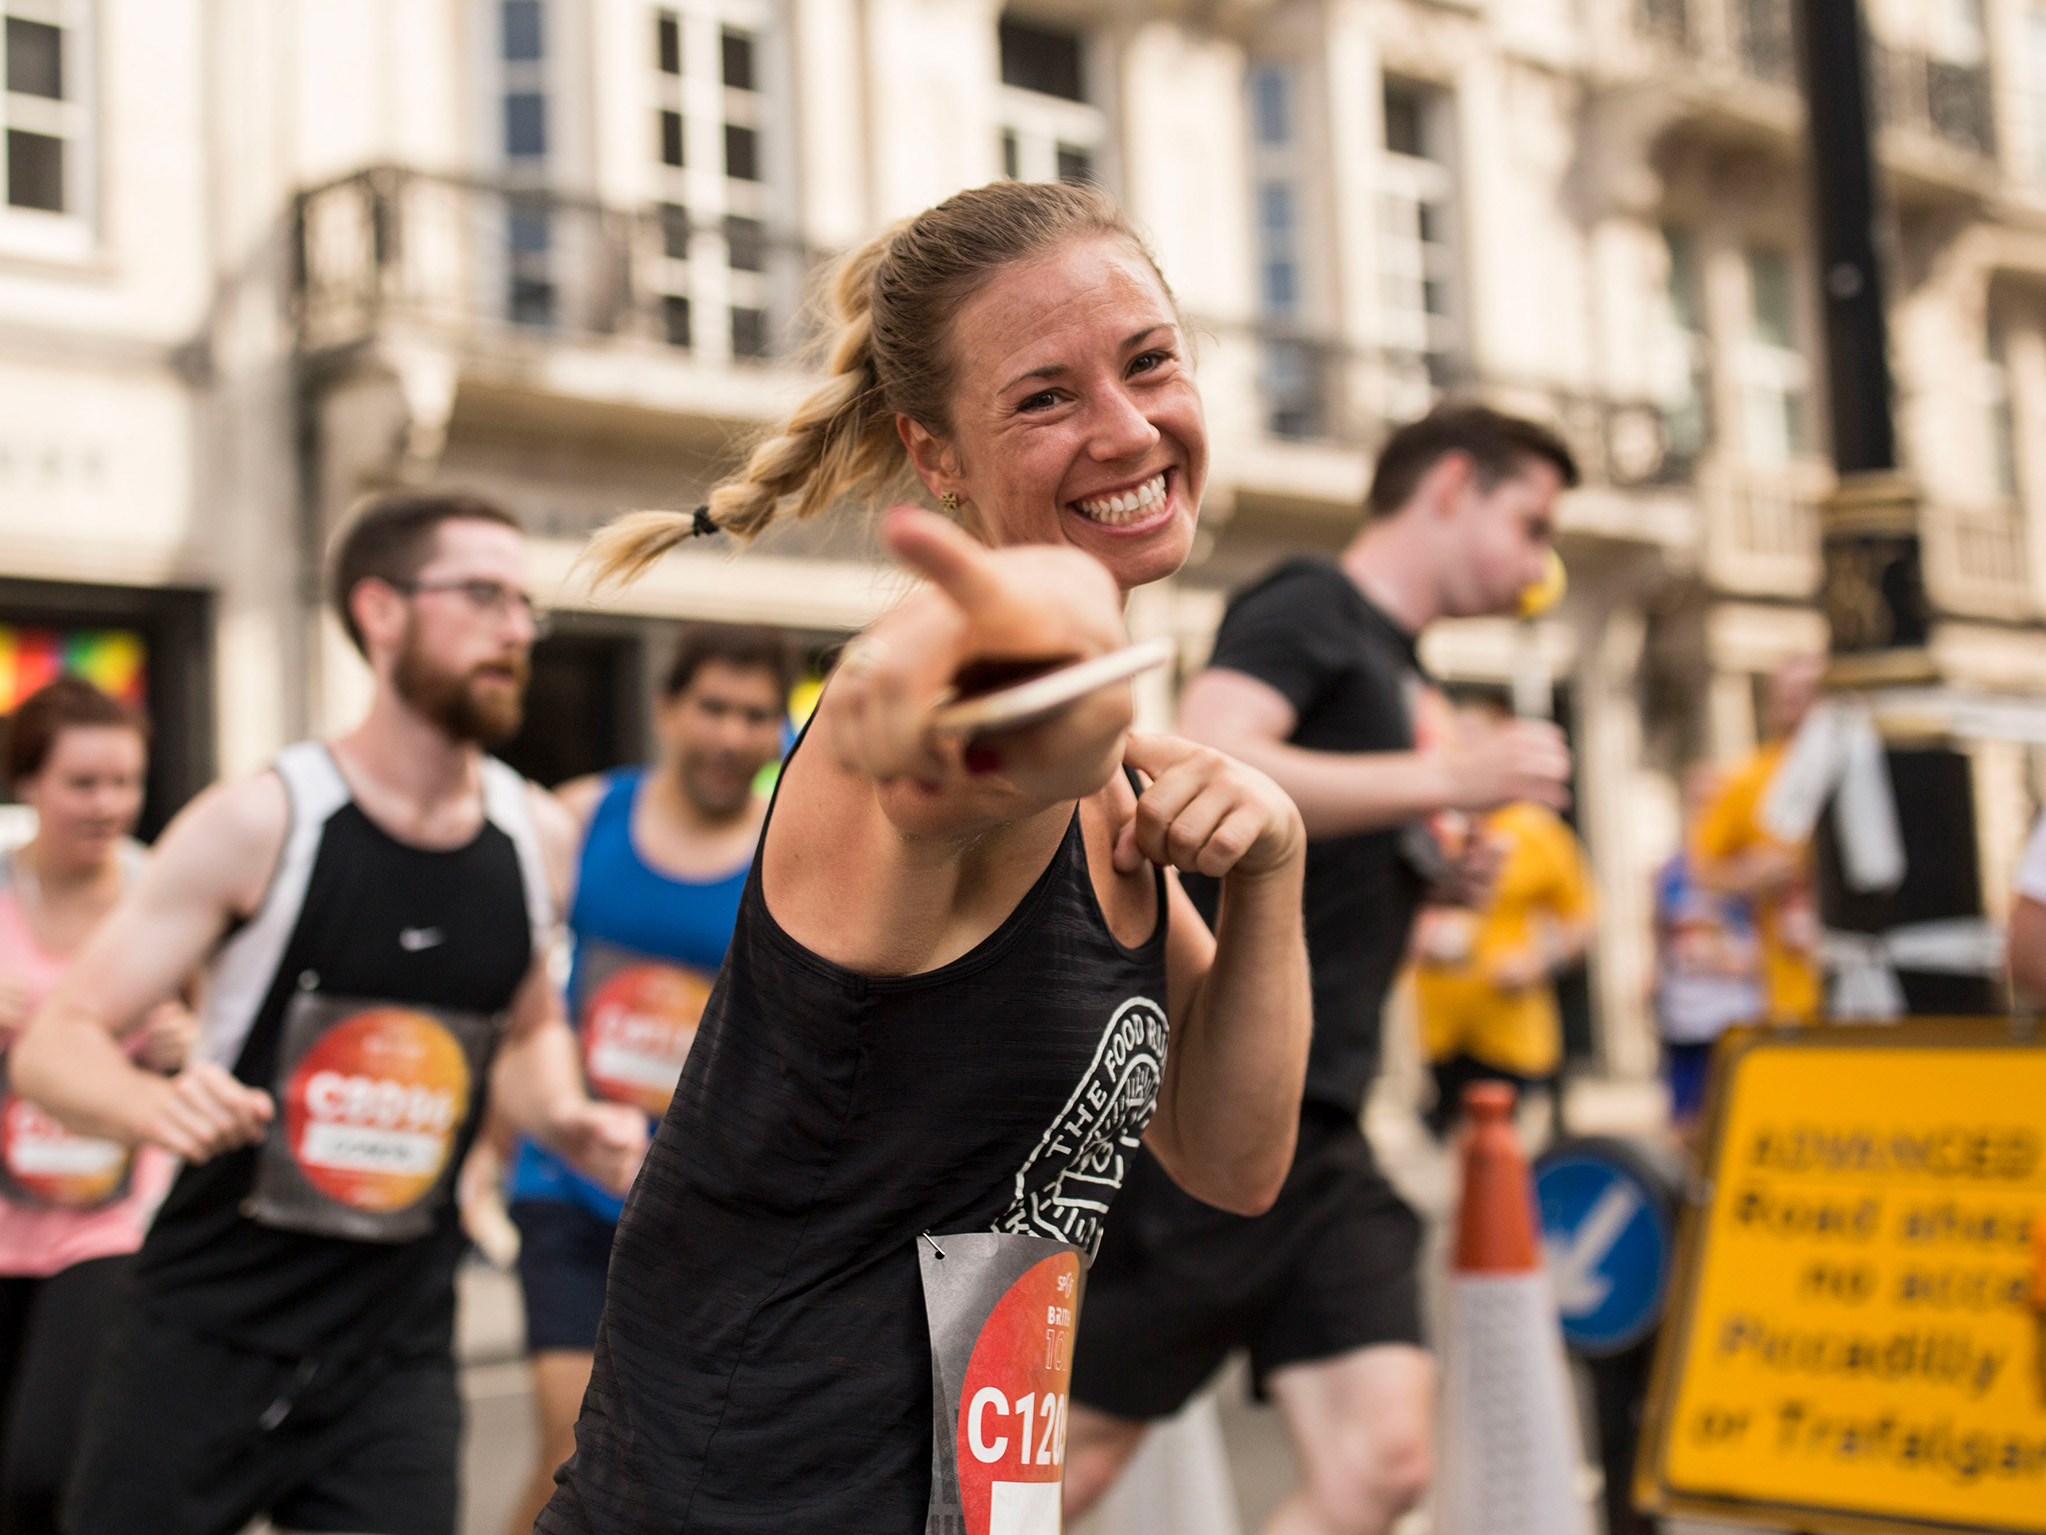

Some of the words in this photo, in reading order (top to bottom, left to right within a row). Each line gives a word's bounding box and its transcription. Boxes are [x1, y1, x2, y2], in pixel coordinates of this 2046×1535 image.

[1046, 1080, 1107, 1158] THE
[1103, 1014, 1144, 1082] FOOD
[1902, 1194, 2034, 1250] ahea
[1900, 1266, 2035, 1312] acce
[1045, 1329, 1070, 1371] 10
[1715, 1310, 2006, 1396] Piccadilly
[967, 1386, 1067, 1466] C120
